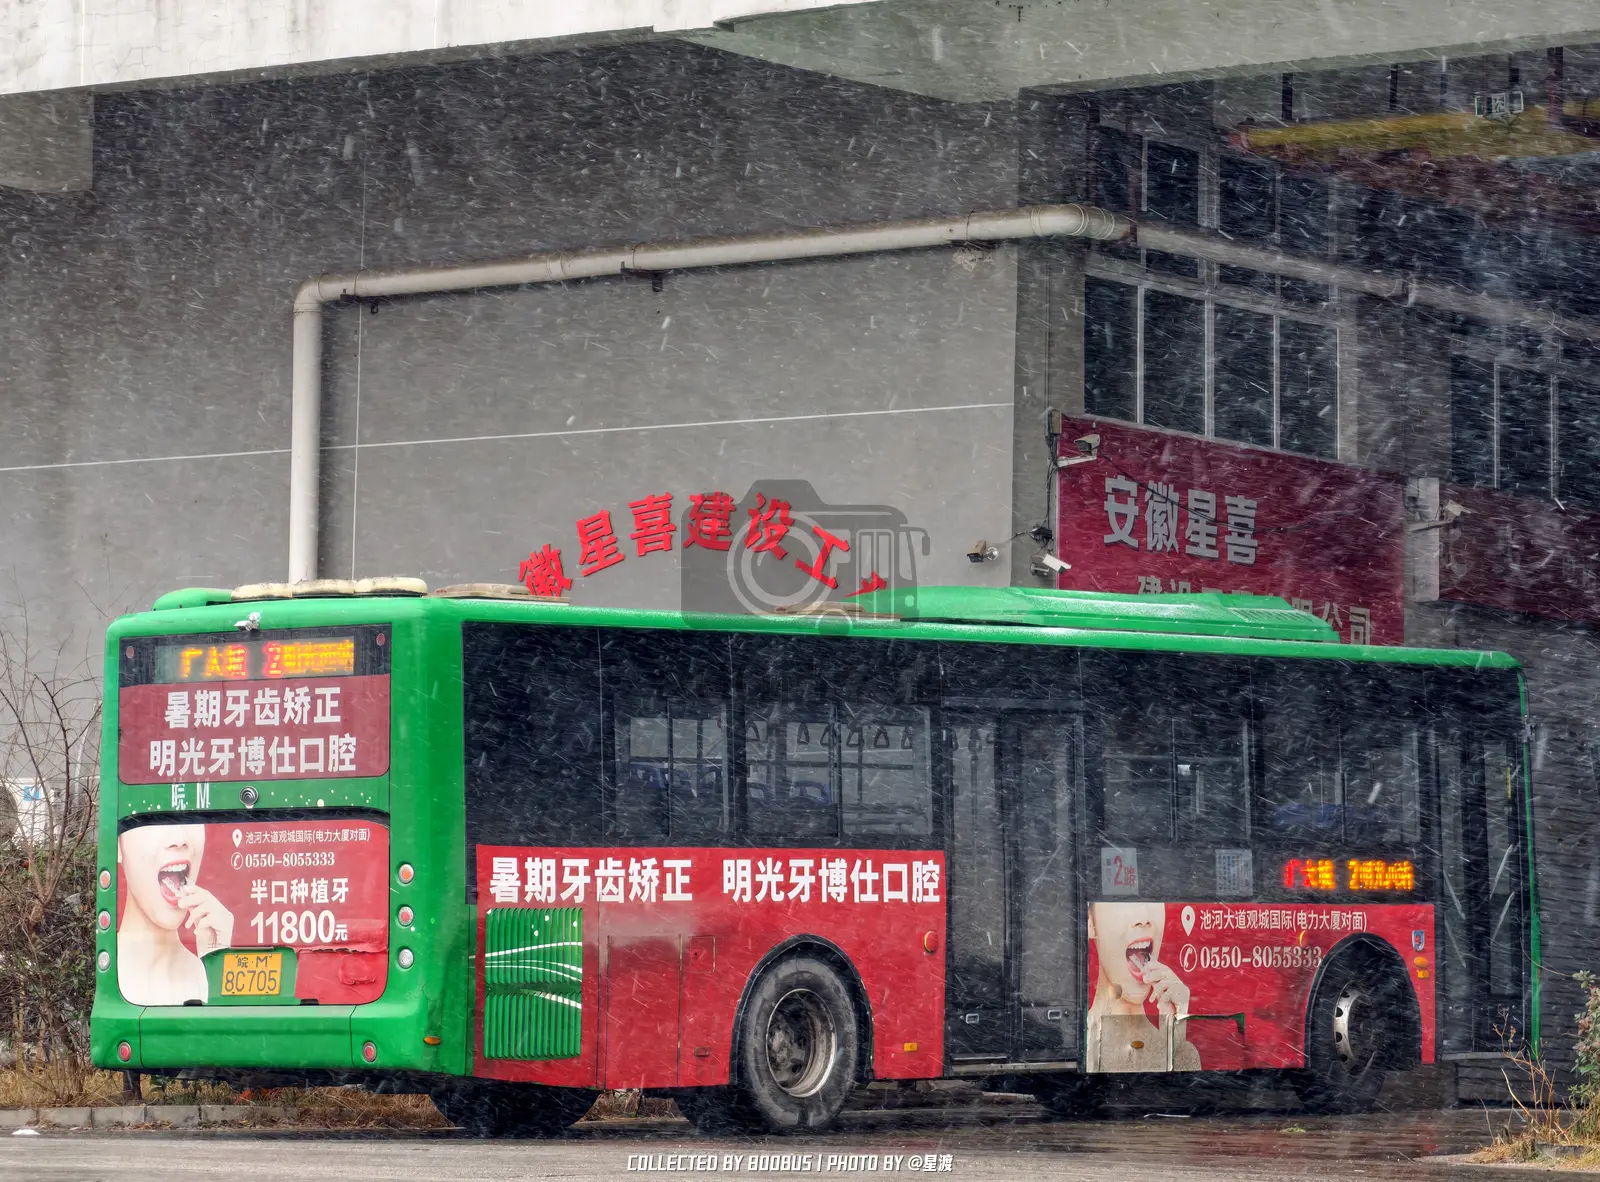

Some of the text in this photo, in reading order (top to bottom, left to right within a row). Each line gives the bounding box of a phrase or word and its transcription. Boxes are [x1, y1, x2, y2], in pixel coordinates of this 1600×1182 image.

[1104, 475, 1257, 564] 安徽星喜
[165, 686, 341, 728] 暑期牙齿矫正
[150, 733, 357, 776] 明光牙博仕口腔
[245, 852, 335, 868] 0550-8055333
[250, 877, 349, 905] 半口种植牙
[490, 857, 940, 903] 暑期牙齿矫正 明光牙博仕口腔
[250, 909, 348, 944] 11800元
[1201, 945, 1322, 968] 0550-8055333
[224, 969, 278, 992] 8C705
